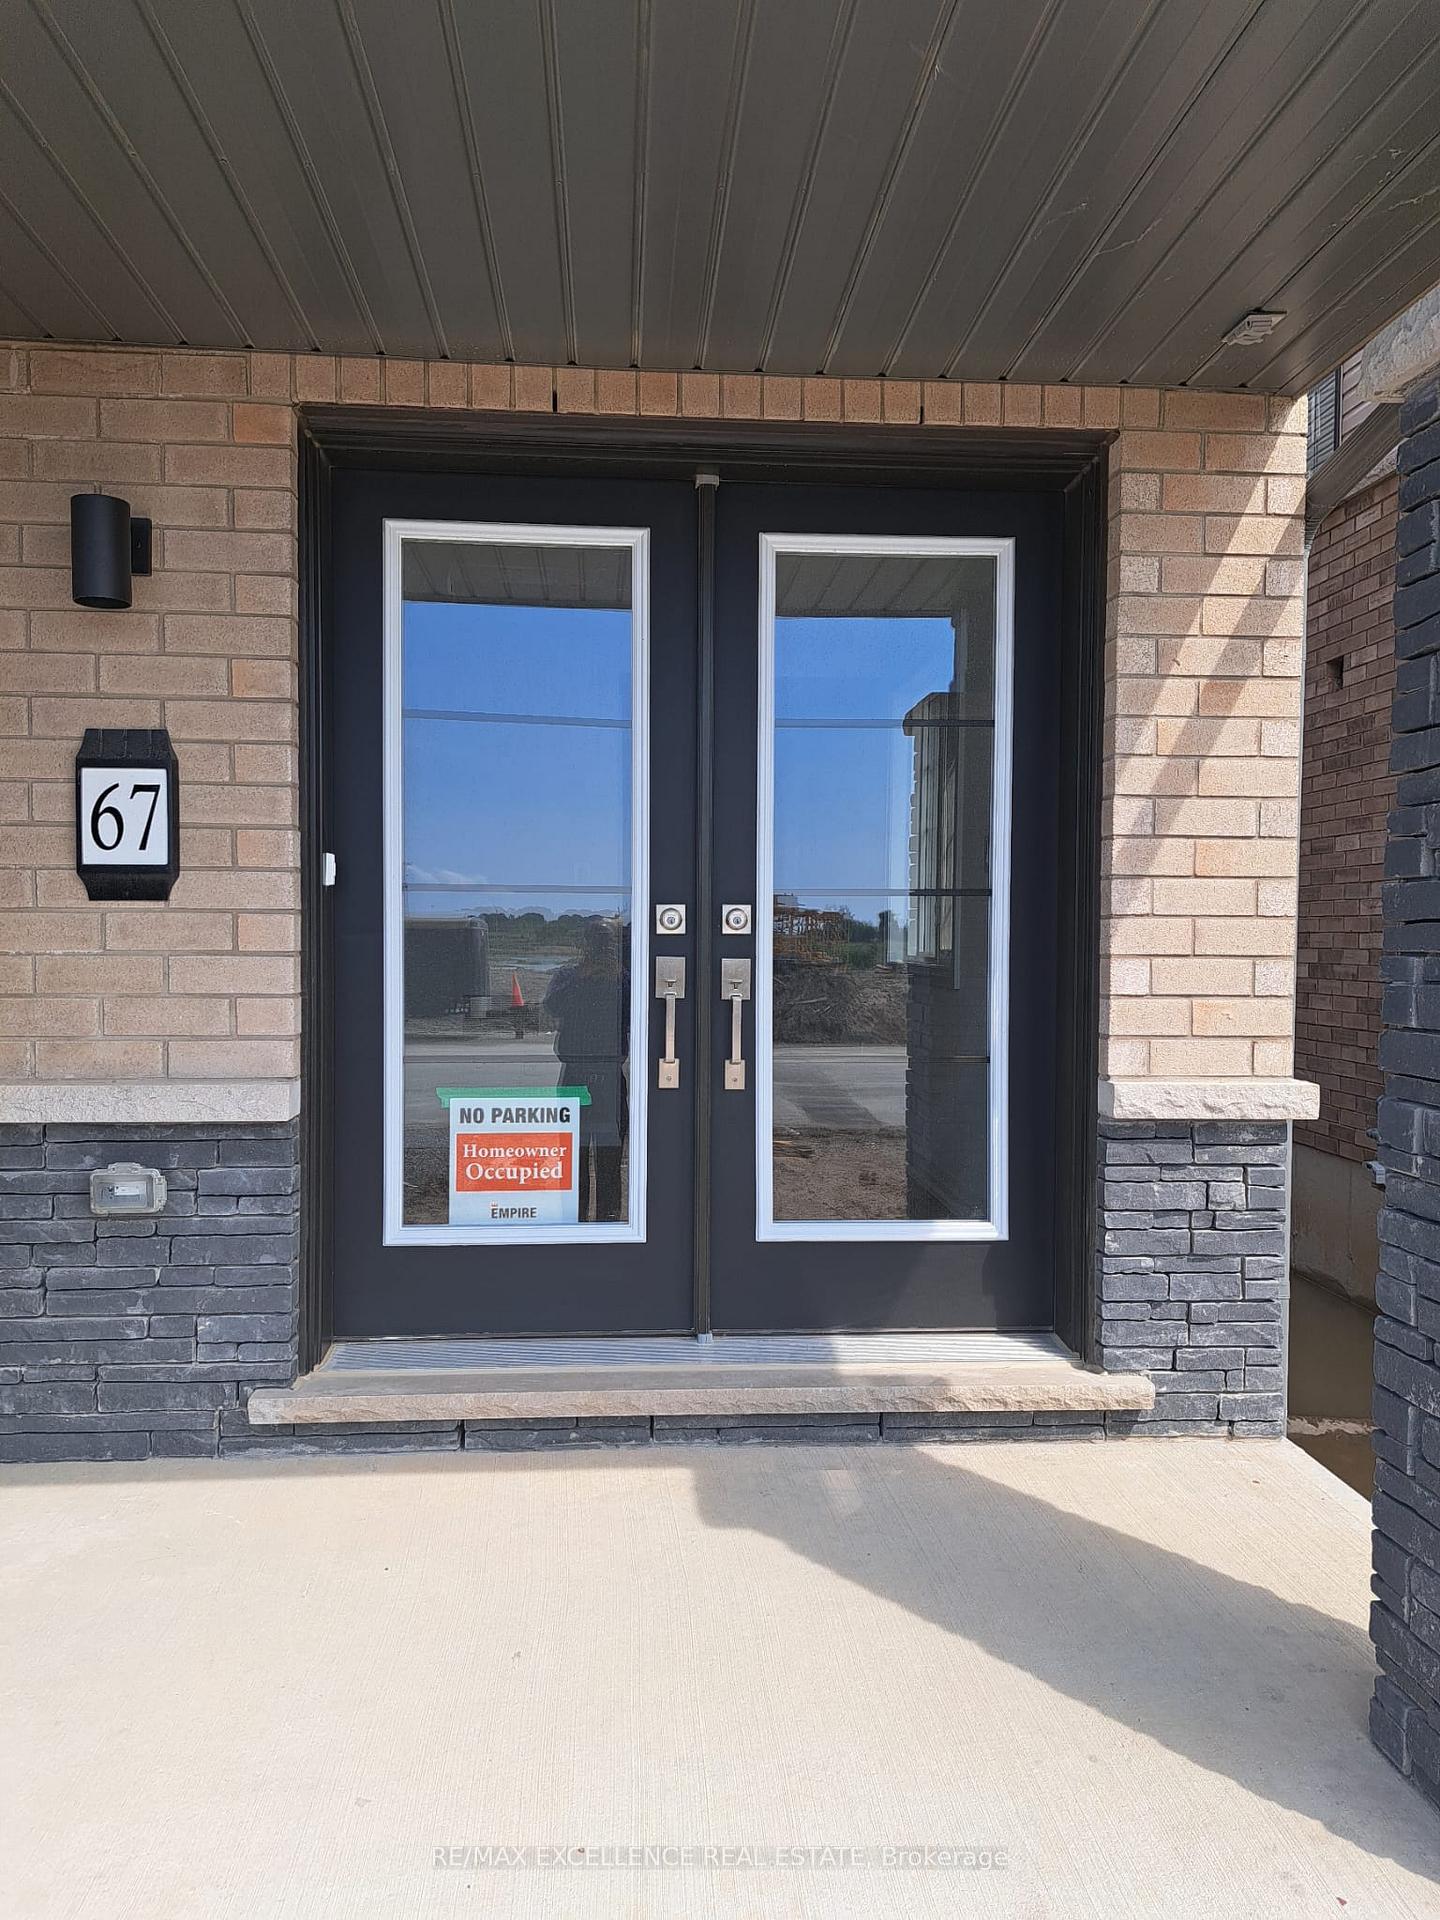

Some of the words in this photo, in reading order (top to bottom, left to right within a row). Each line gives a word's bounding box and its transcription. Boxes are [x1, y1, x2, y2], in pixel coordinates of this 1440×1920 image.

[90, 782, 161, 851] 67
[459, 1107, 485, 1124] NO
[491, 1107, 571, 1124] PARKING
[463, 1143, 567, 1158] Homeowner
[465, 1161, 564, 1185] Occupied
[491, 1207, 537, 1219] EMPIRE
